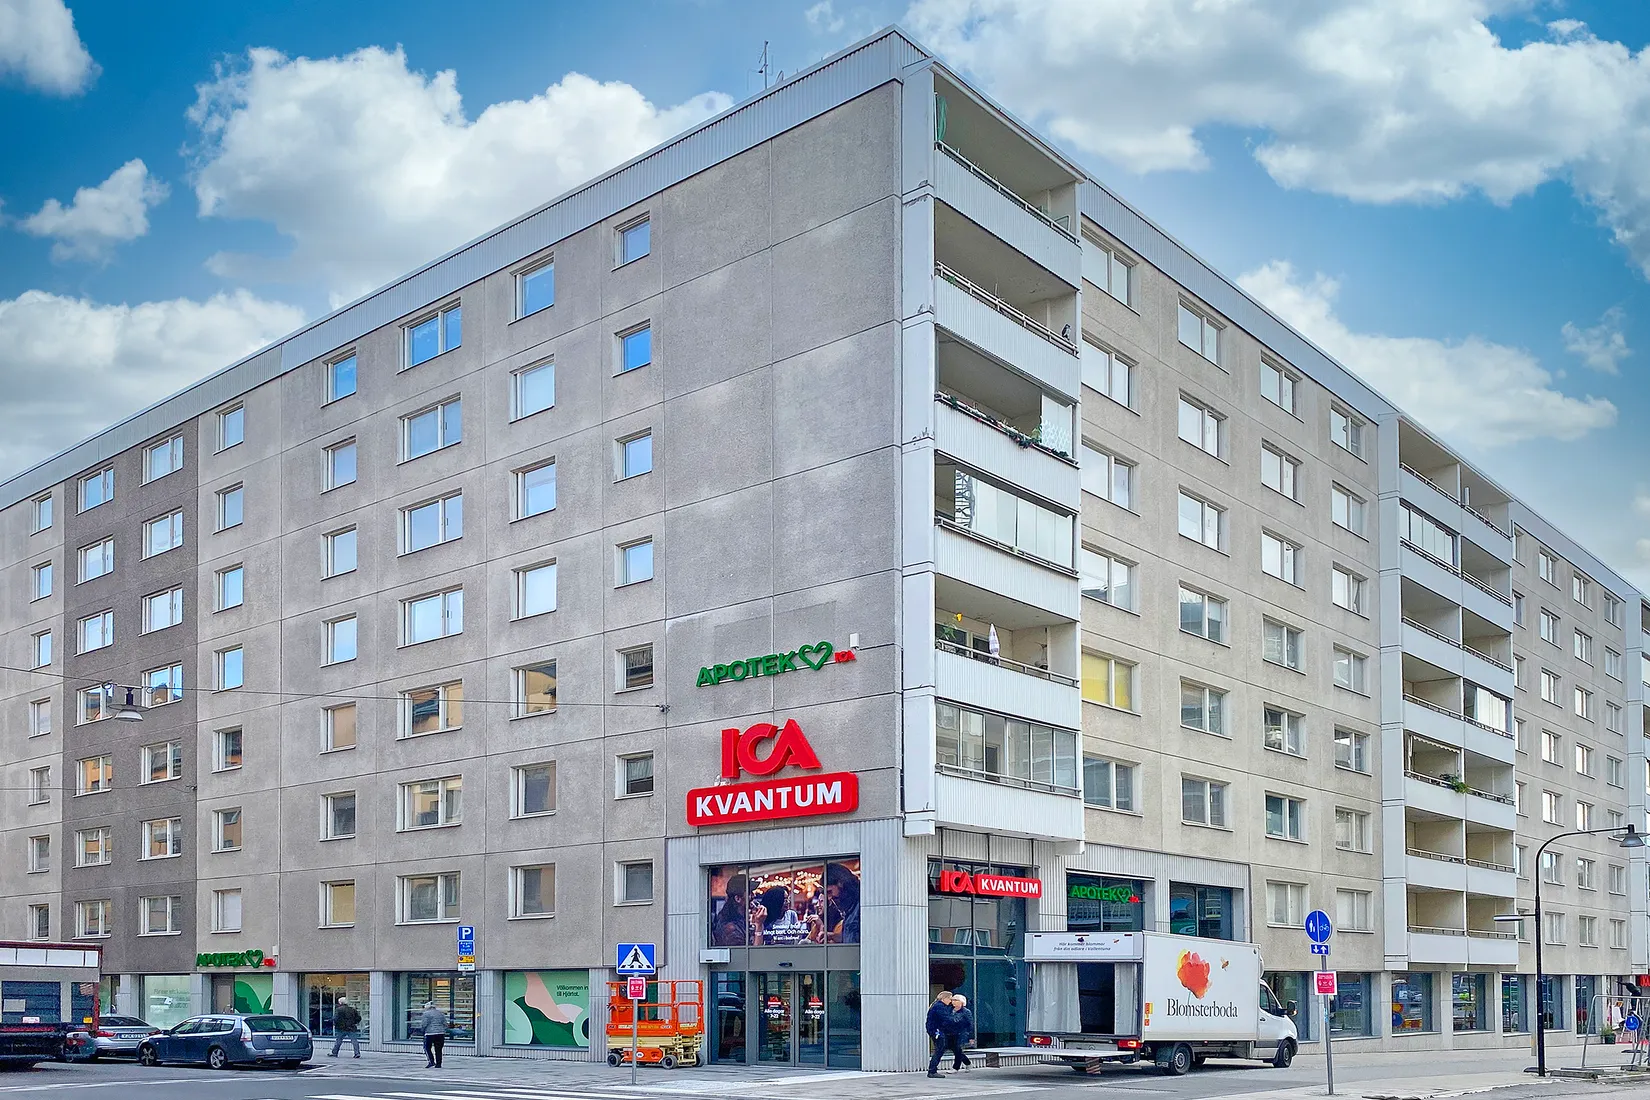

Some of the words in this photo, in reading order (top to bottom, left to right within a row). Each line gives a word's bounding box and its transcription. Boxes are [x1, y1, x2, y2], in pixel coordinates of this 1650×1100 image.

[696, 651, 797, 687] APOTEK
[721, 718, 822, 779] ICA
[696, 781, 842, 817] KVANTUM
[940, 870, 976, 894] ICA
[981, 879, 1039, 894] KVANTUM
[1070, 885, 1119, 901] APOTEK
[462, 927, 471, 939] P
[196, 953, 247, 967] APOTEK
[1167, 998, 1238, 1017] Blomsterboda
